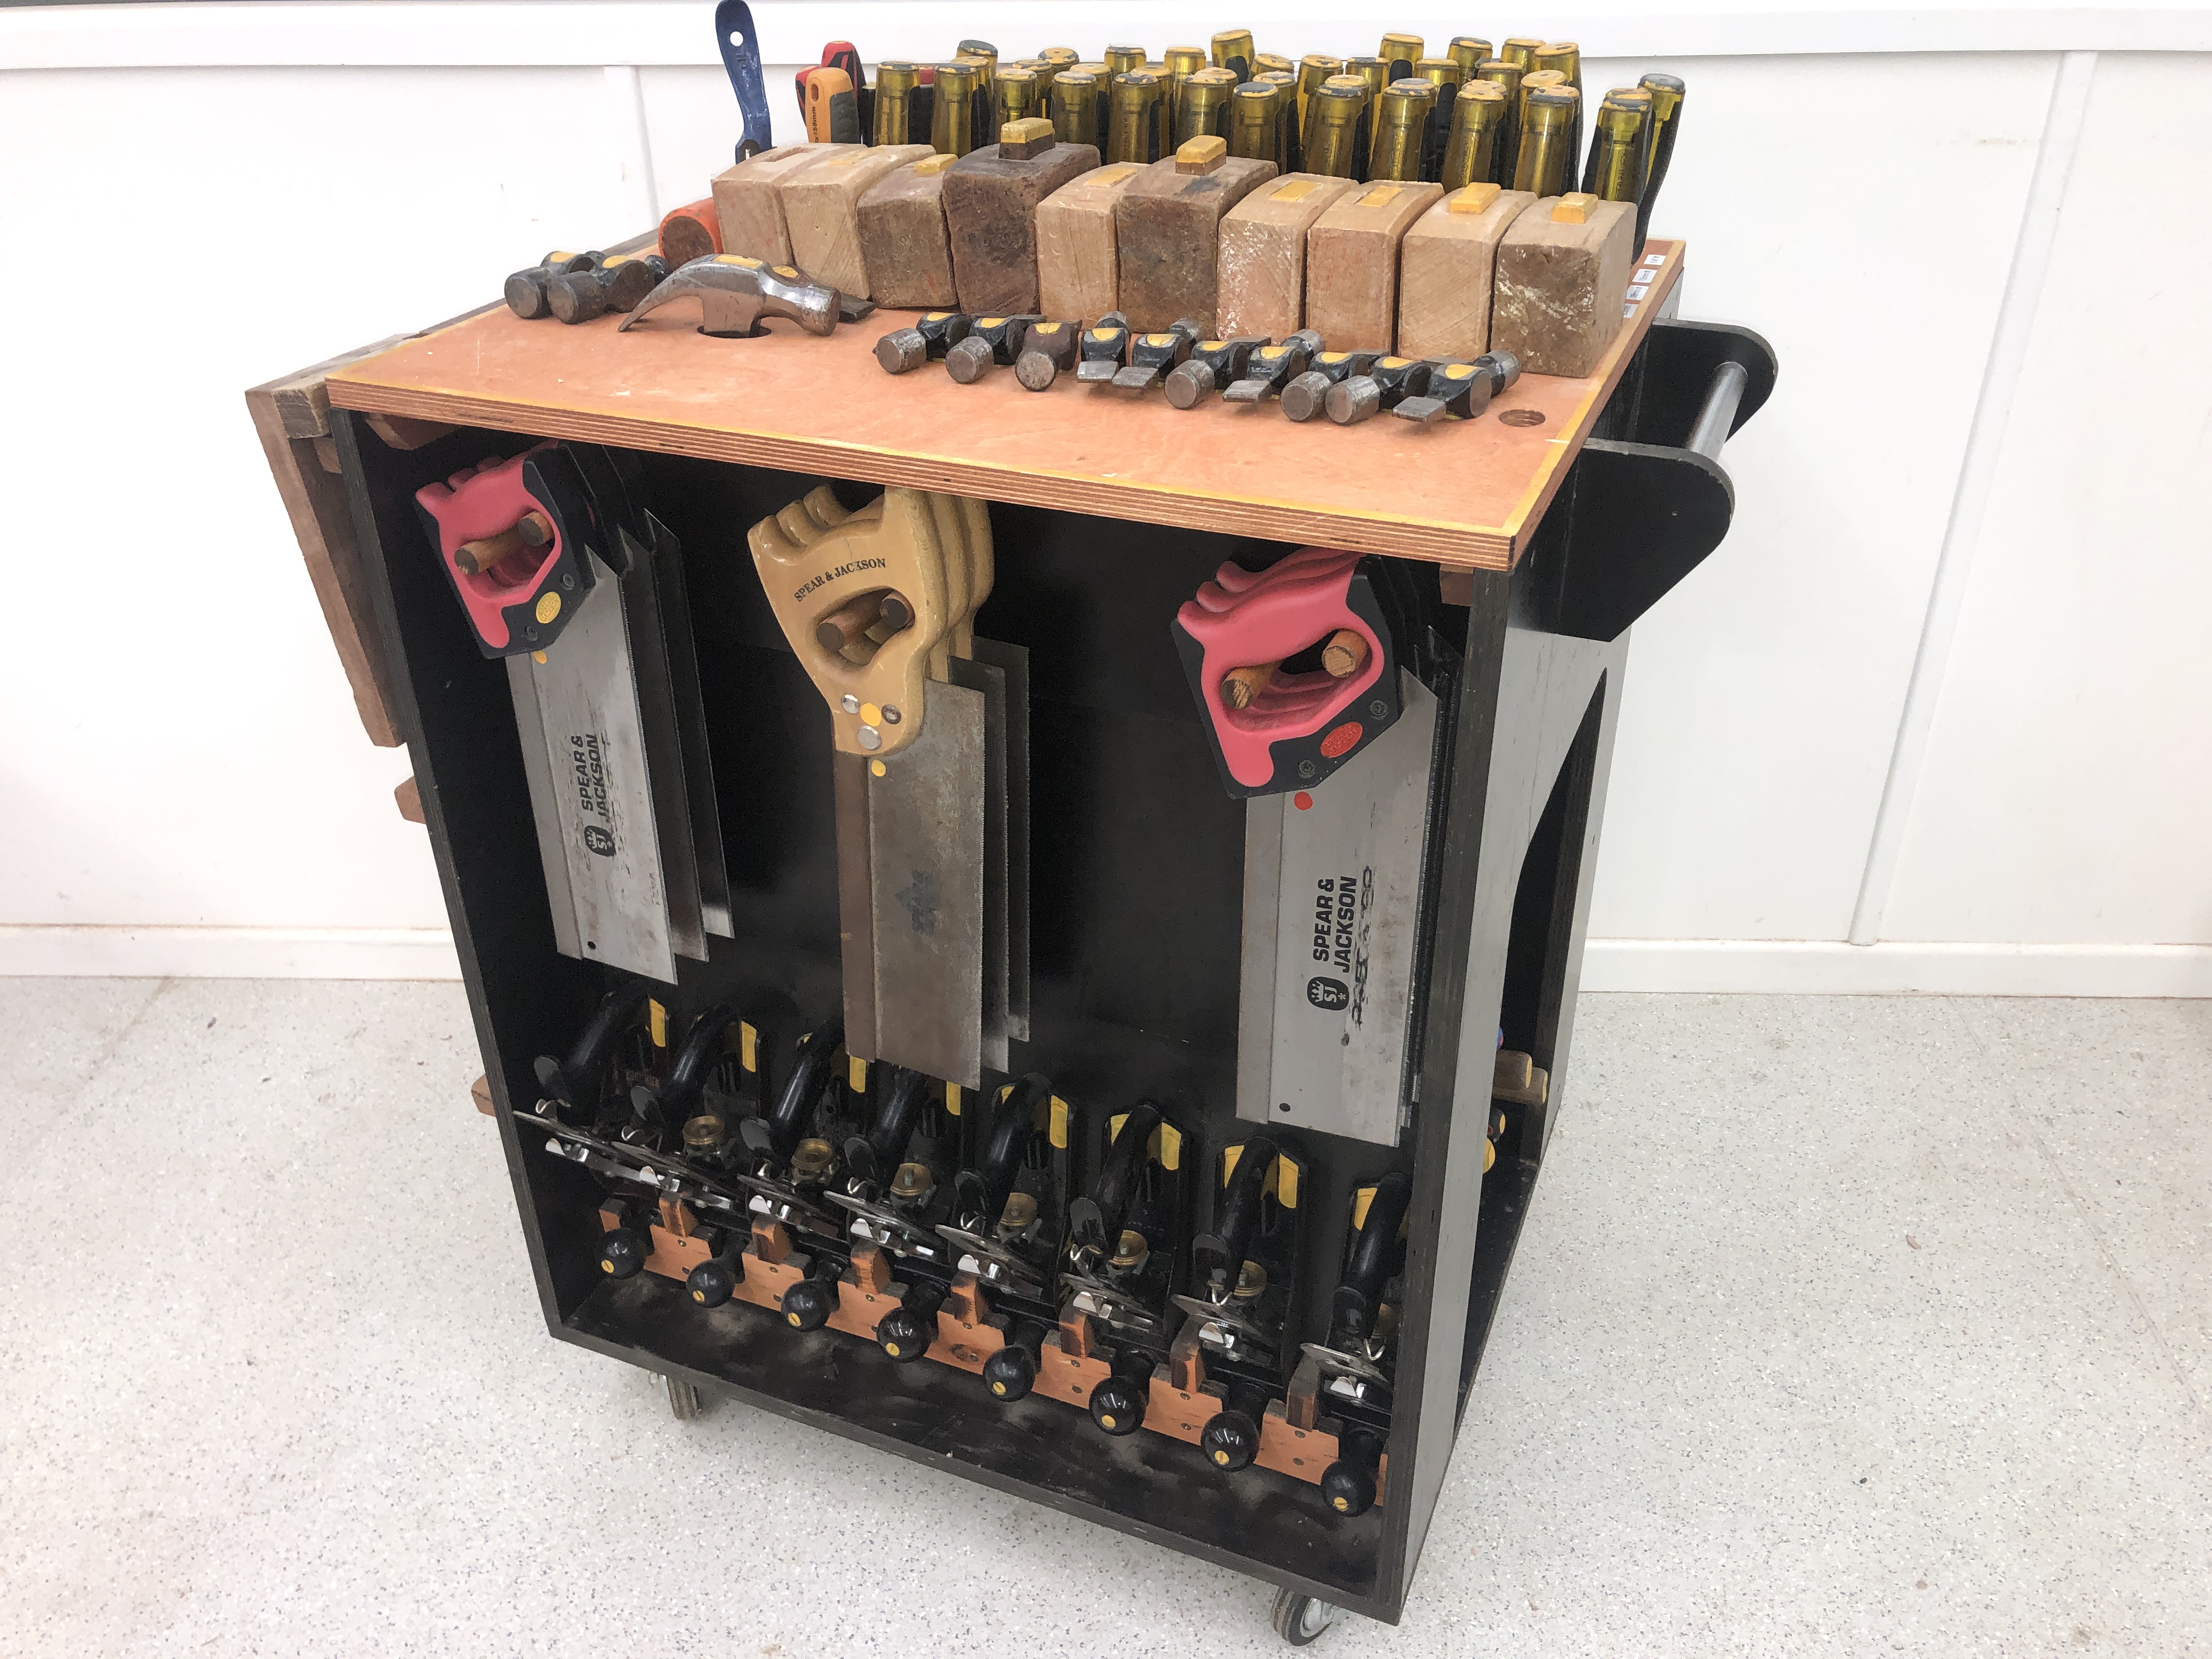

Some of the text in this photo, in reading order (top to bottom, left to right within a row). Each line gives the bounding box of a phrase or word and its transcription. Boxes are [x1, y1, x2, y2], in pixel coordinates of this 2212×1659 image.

[794, 558, 886, 602] SPEAR & JACKSON
[571, 735, 593, 811] SPEAR &
[585, 733, 607, 818] JACKSON
[1313, 878, 1334, 962] SPEAR &
[1334, 876, 1357, 973] JACKSON
